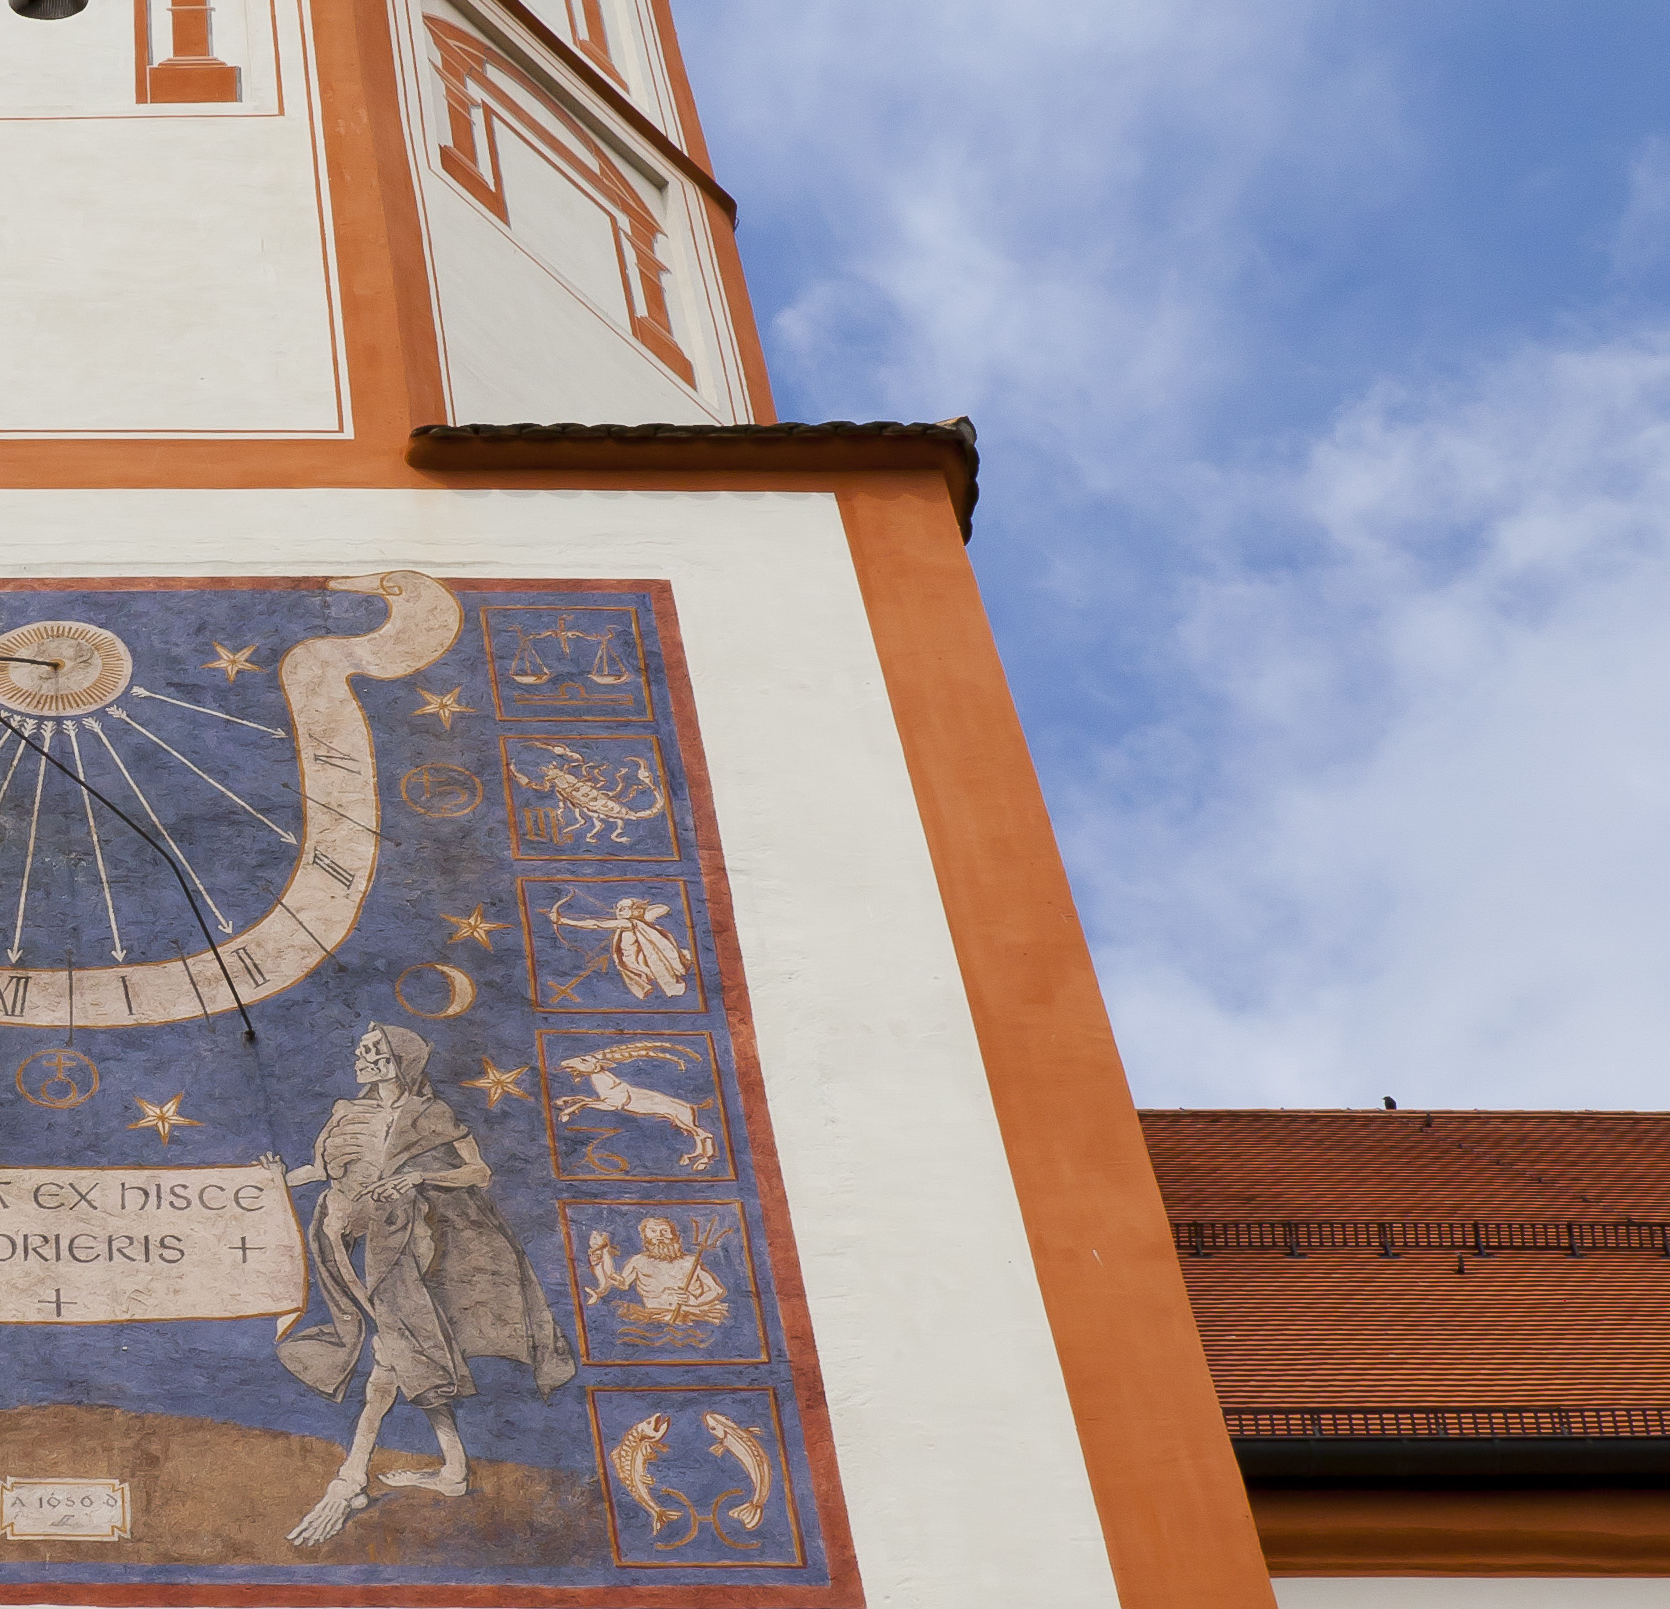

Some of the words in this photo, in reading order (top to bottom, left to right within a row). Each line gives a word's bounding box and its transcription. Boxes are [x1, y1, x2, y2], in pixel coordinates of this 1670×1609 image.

[313, 846, 355, 890] III
[231, 946, 271, 989] II
[120, 975, 135, 1015] I
[33, 1181, 99, 1211] EX
